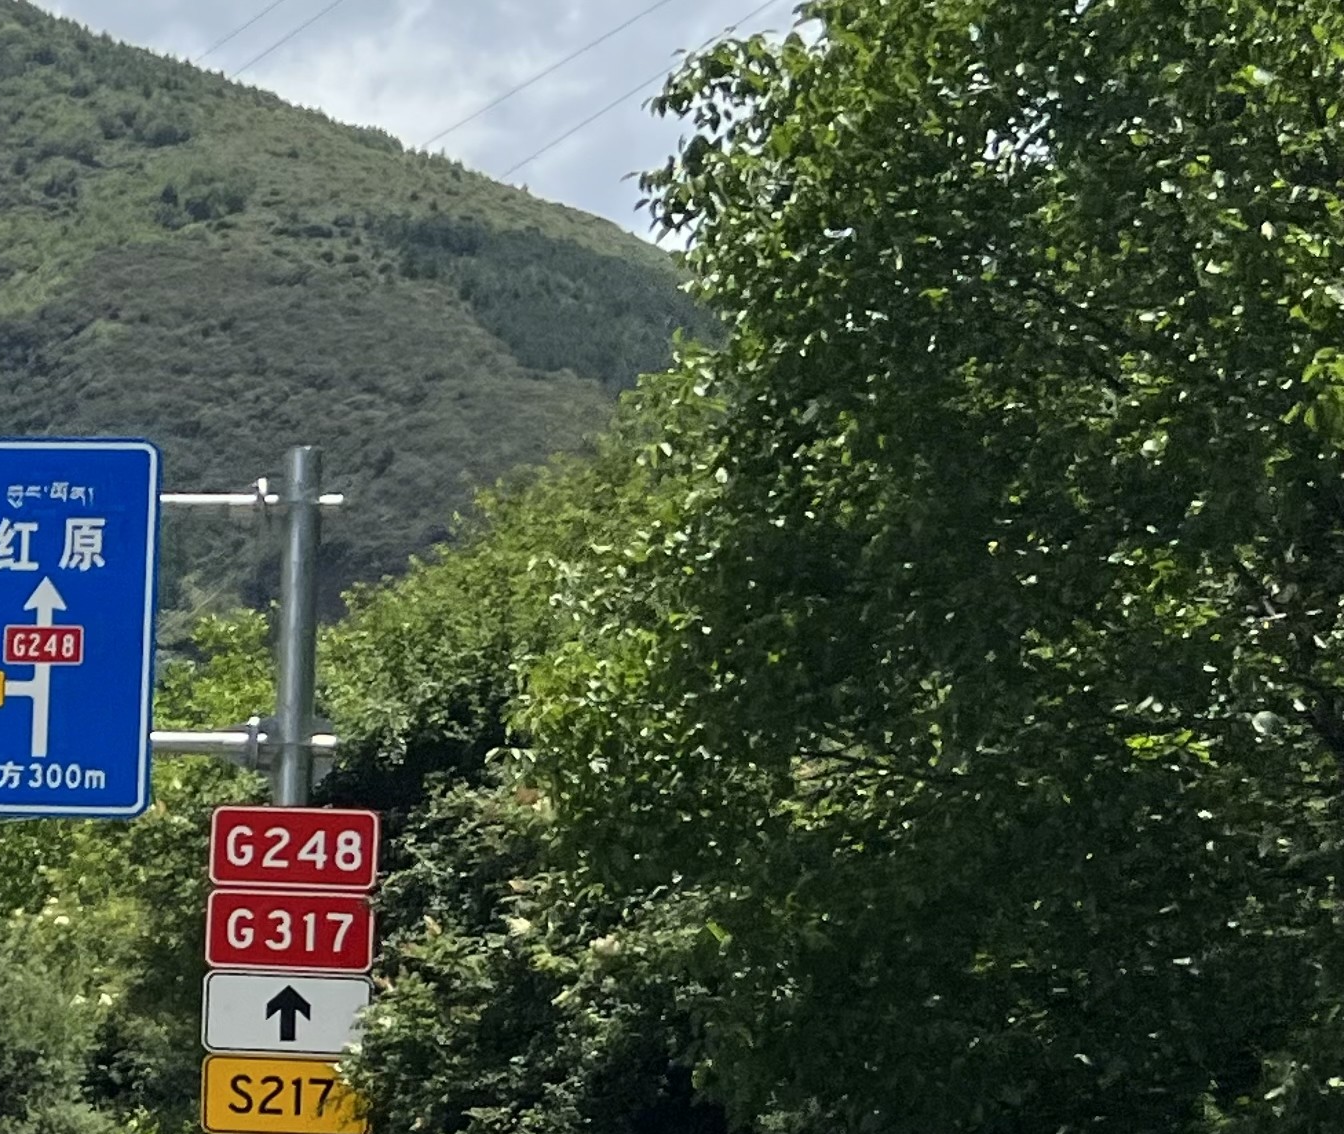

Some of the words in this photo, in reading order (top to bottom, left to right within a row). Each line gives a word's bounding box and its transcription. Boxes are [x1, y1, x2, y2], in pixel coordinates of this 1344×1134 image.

[13, 633, 75, 658] G248
[226, 825, 362, 871] G248
[227, 908, 354, 953] G317
[228, 1074, 335, 1117] S217
